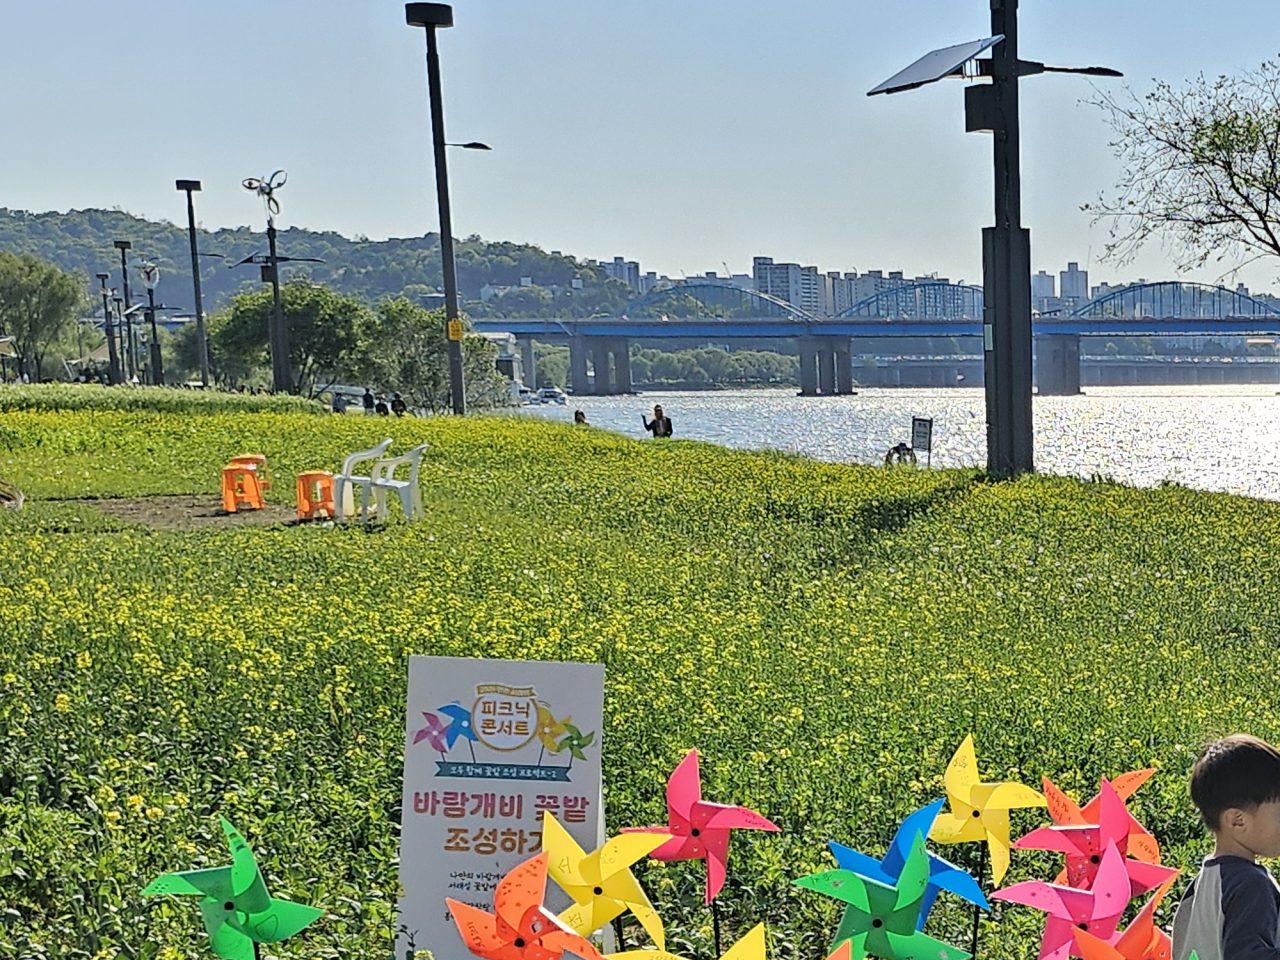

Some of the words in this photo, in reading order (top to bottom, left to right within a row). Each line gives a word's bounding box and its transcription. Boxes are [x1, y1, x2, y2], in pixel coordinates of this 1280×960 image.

[481, 700, 530, 719] 피크닉
[480, 718, 530, 736] 콘서트
[450, 765, 464, 775] 모두
[466, 765, 482, 776] 함께
[485, 766, 500, 777] 꽃밭
[413, 790, 524, 820] 바람개비
[534, 794, 590, 823] 꽃밭
[476, 871, 505, 881] 바람개
